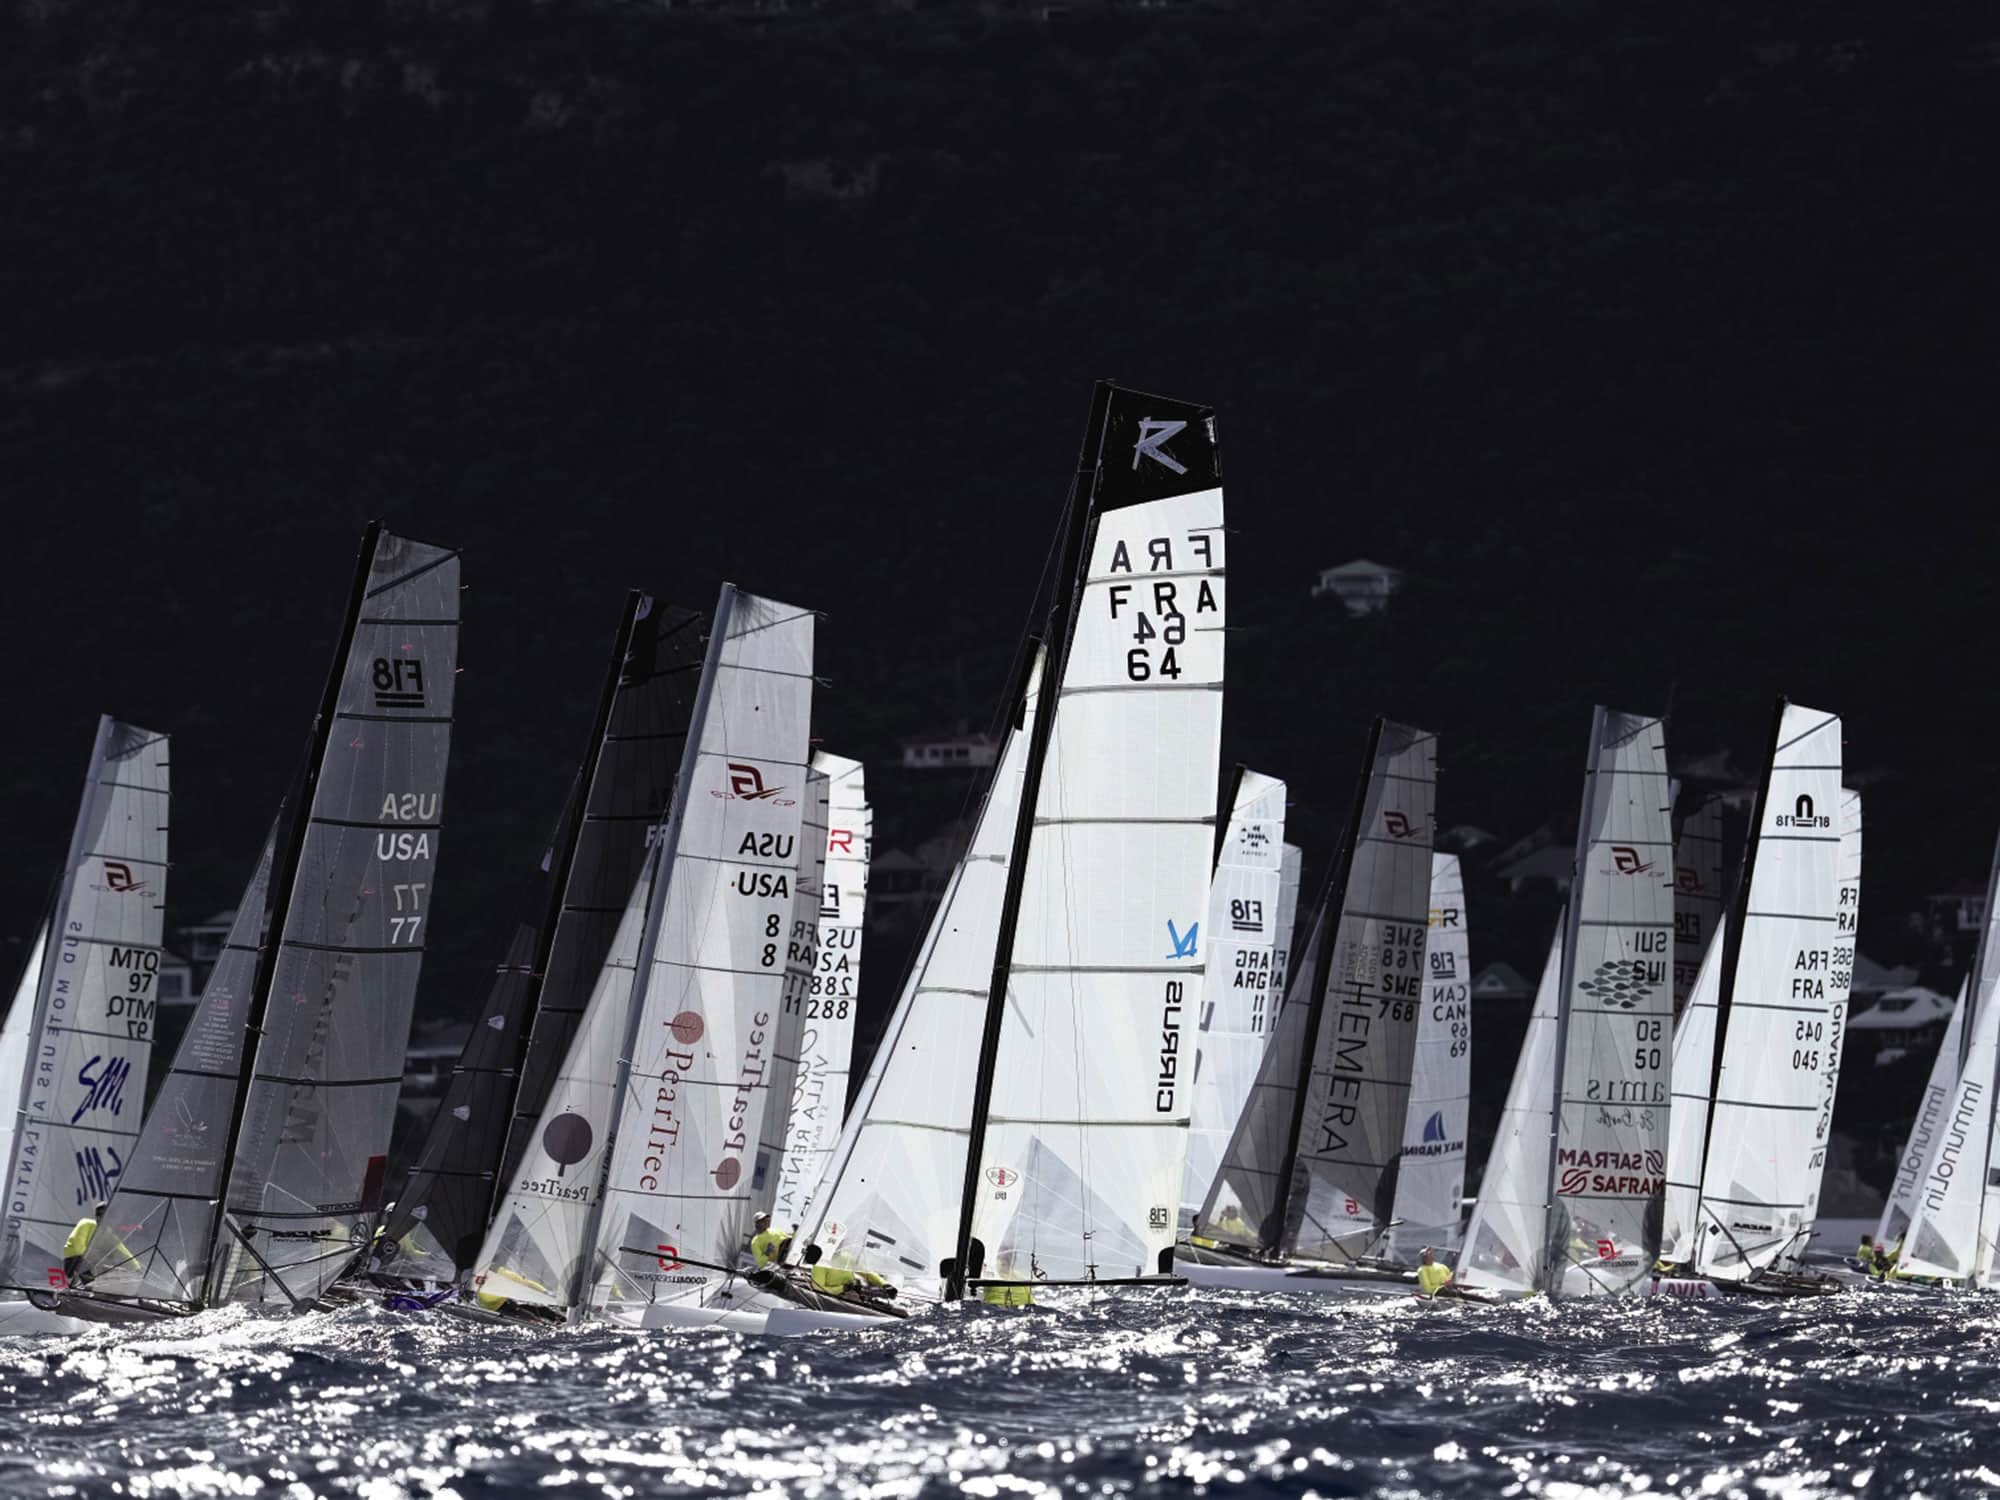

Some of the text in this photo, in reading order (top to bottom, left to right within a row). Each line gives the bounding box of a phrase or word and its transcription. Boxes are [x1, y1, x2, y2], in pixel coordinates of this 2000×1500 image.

[1109, 580, 1217, 619] FRA
[1127, 647, 1181, 681] 64
[377, 833, 430, 861] USA
[738, 872, 789, 898] USA
[390, 917, 422, 944] 77
[765, 914, 780, 937] 8
[1836, 912, 1856, 931] RA
[110, 947, 160, 973] MTQ
[761, 943, 776, 967] 8
[787, 941, 812, 965] RA
[129, 974, 153, 994] 97
[1233, 971, 1266, 989] ARG
[1382, 974, 1420, 996] SWE
[1793, 979, 1824, 999] FRA
[807, 998, 849, 1019] 288
[1378, 1000, 1414, 1022] 768
[1432, 1004, 1466, 1022] CAN
[1251, 1014, 1264, 1034] 11
[1450, 1040, 1467, 1058] 69
[1634, 1048, 1661, 1070] 50
[1792, 1049, 1818, 1071] 045
[1317, 979, 1376, 1153] HEMERA
[639, 1047, 694, 1192] PearTree
[1592, 1174, 1665, 1195] SAFRAM
[1666, 1281, 1707, 1297] AVIS
